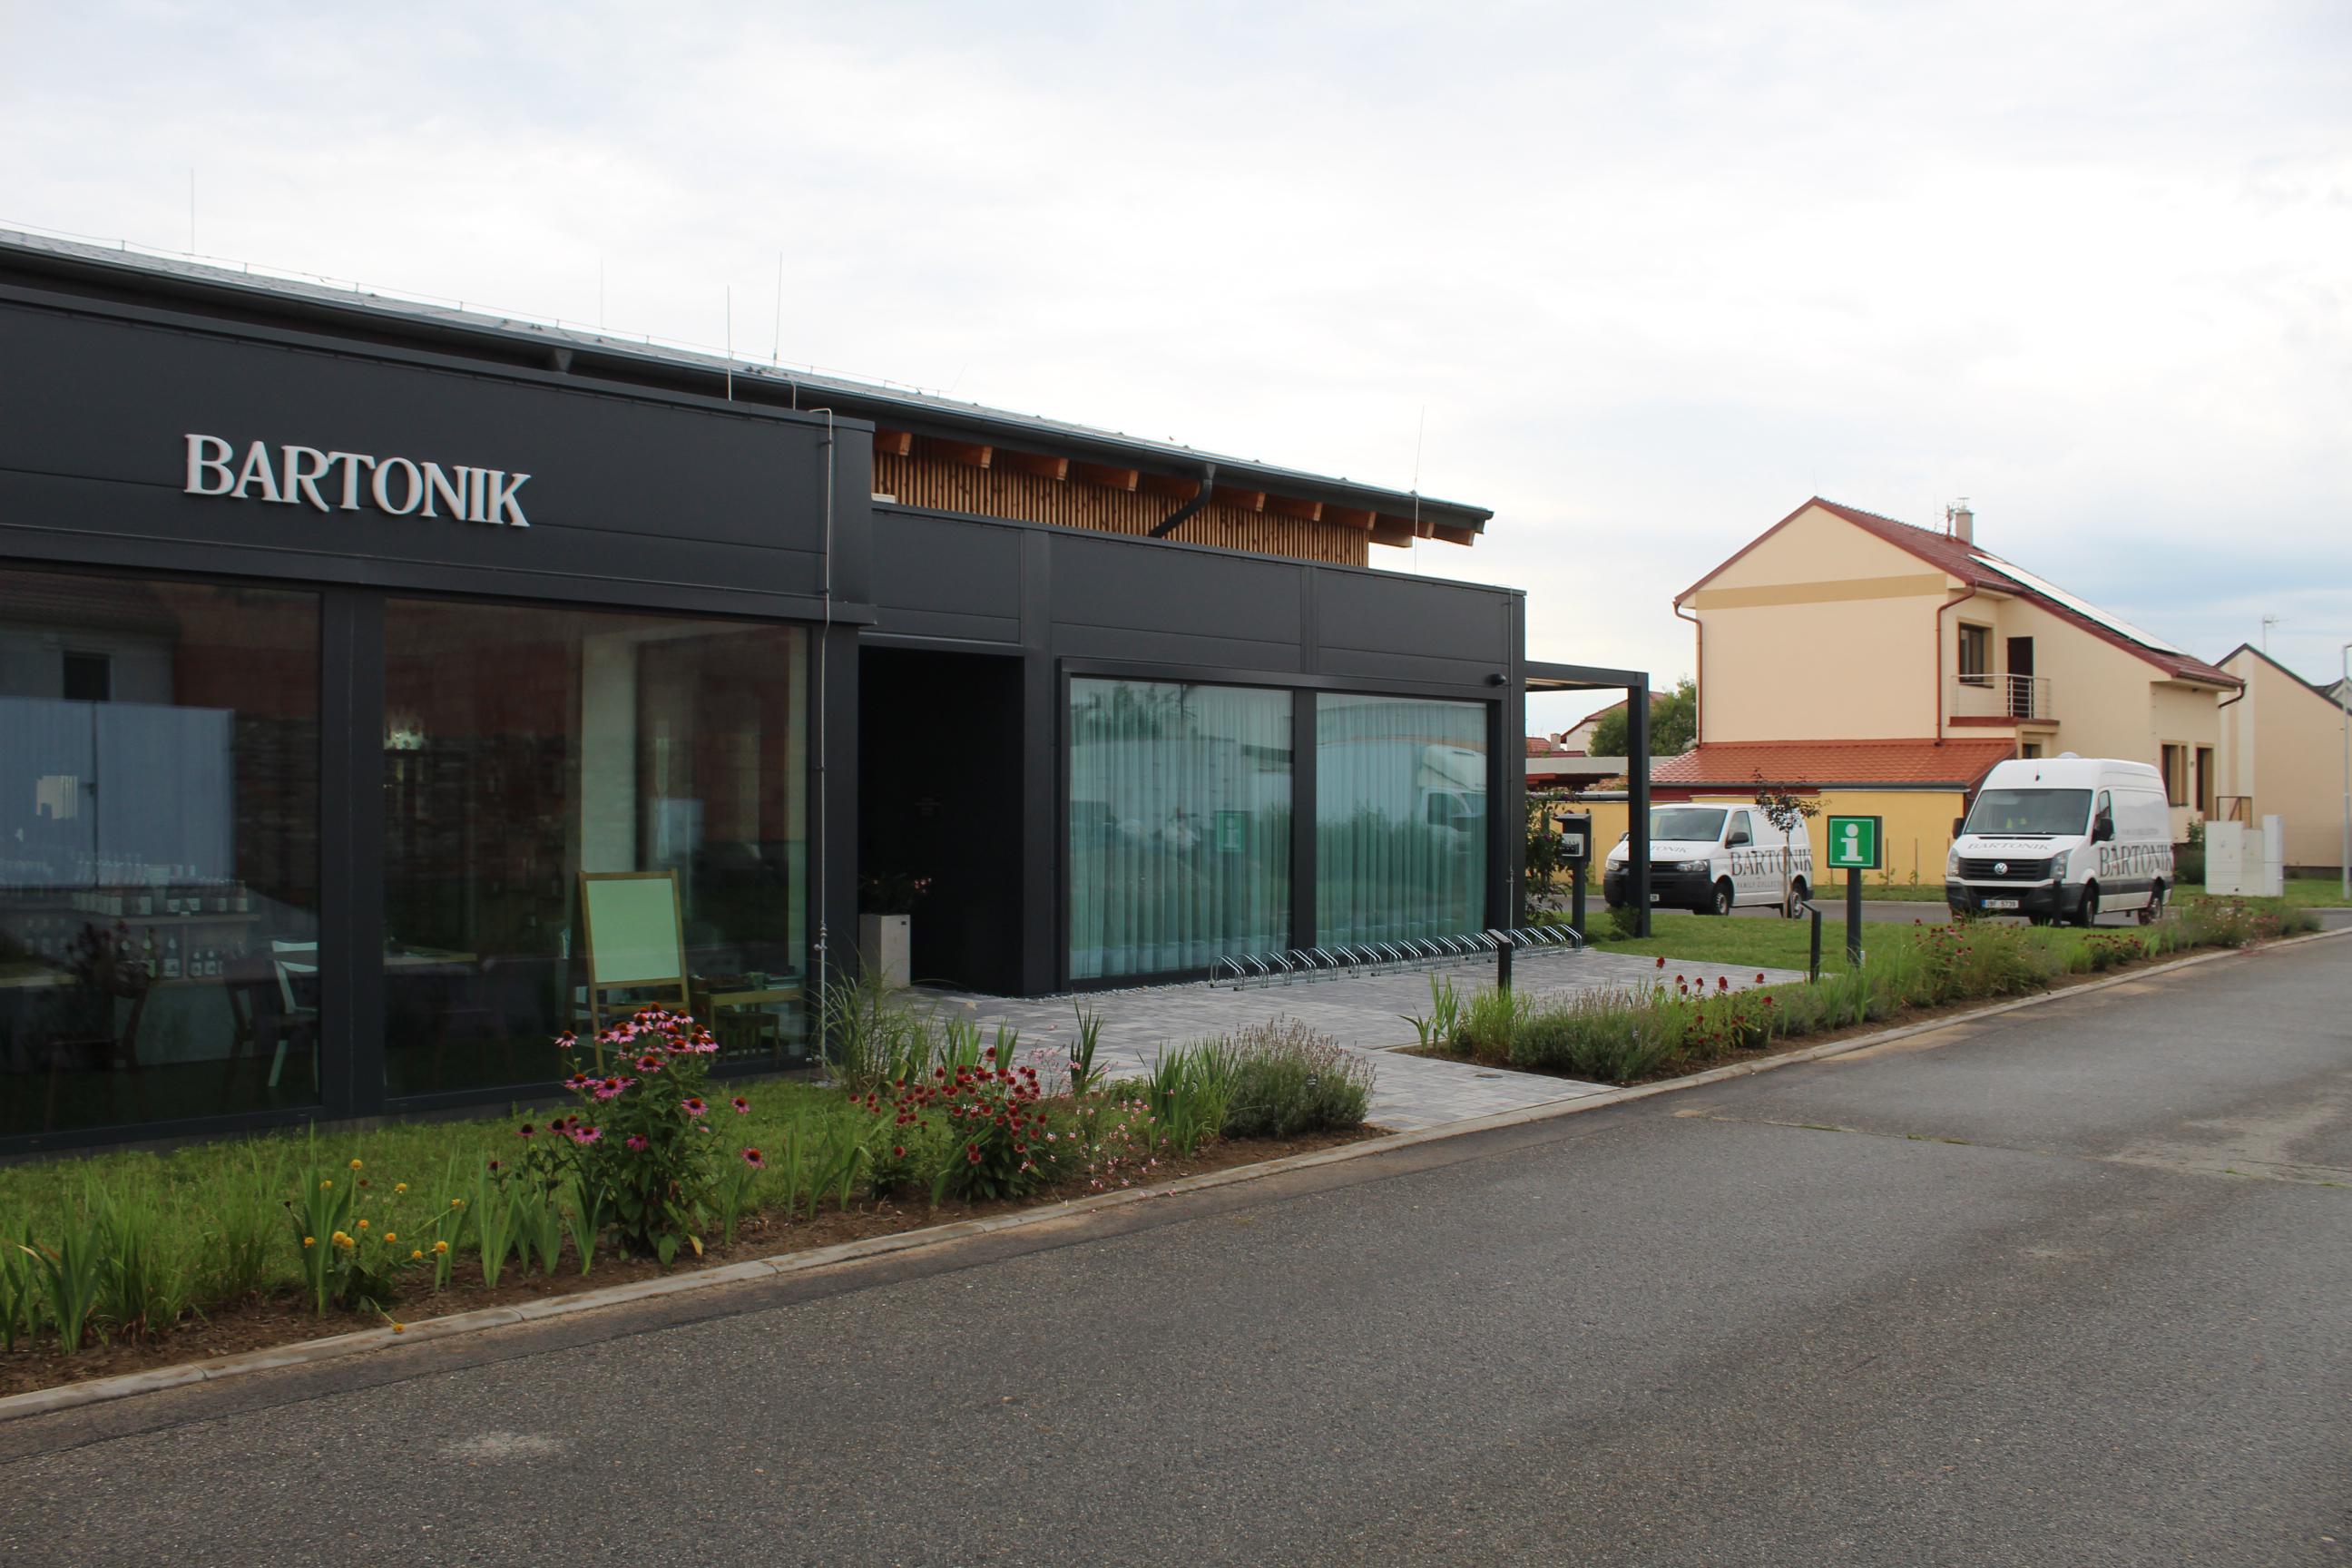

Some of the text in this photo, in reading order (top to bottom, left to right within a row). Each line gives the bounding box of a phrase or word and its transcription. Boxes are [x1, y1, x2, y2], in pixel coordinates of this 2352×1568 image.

[183, 433, 532, 528] BARTONIK
[1967, 842, 2052, 850] BARTONIK
[2100, 844, 2173, 877] BARTONIK
